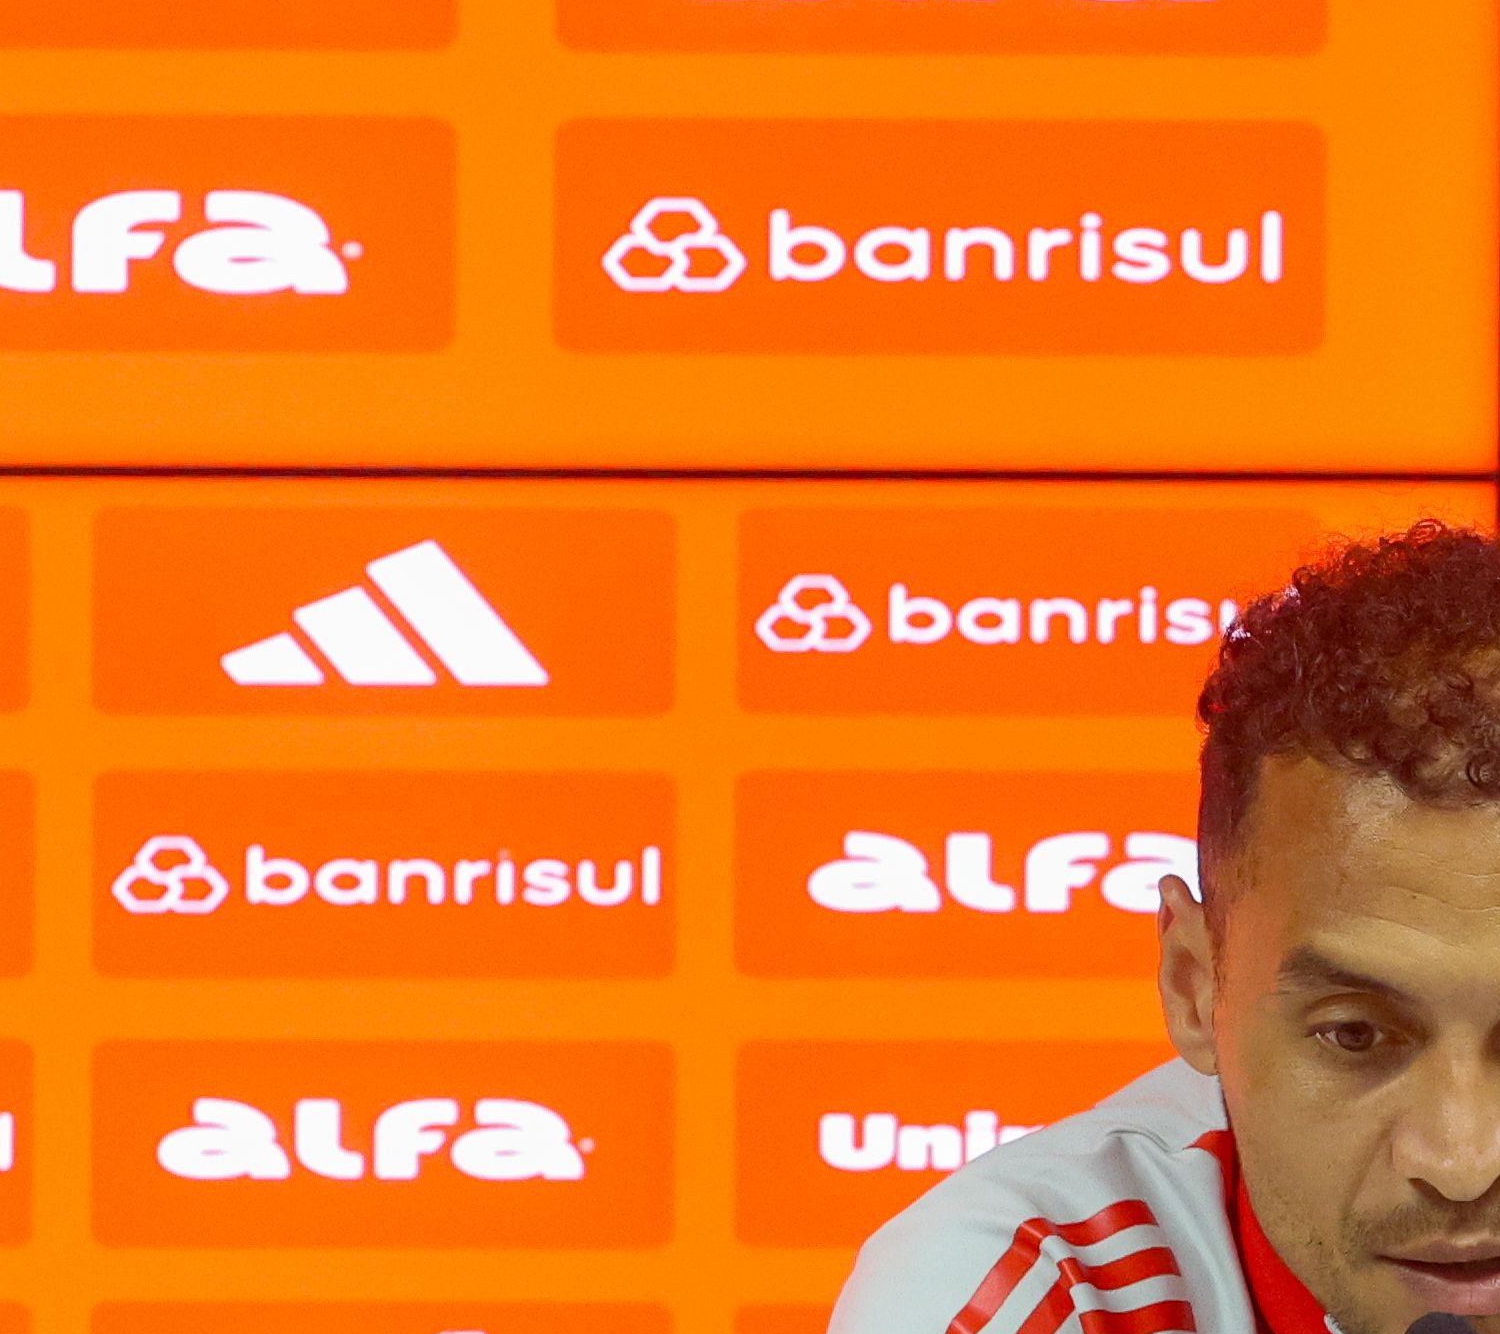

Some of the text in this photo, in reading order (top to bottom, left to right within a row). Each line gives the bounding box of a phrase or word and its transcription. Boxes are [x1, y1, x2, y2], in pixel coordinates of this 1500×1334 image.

[770, 209, 1282, 283] banrisul
[888, 584, 1245, 644] banris
[246, 845, 660, 906] banrisul
[157, 1098, 594, 1180] alfa
